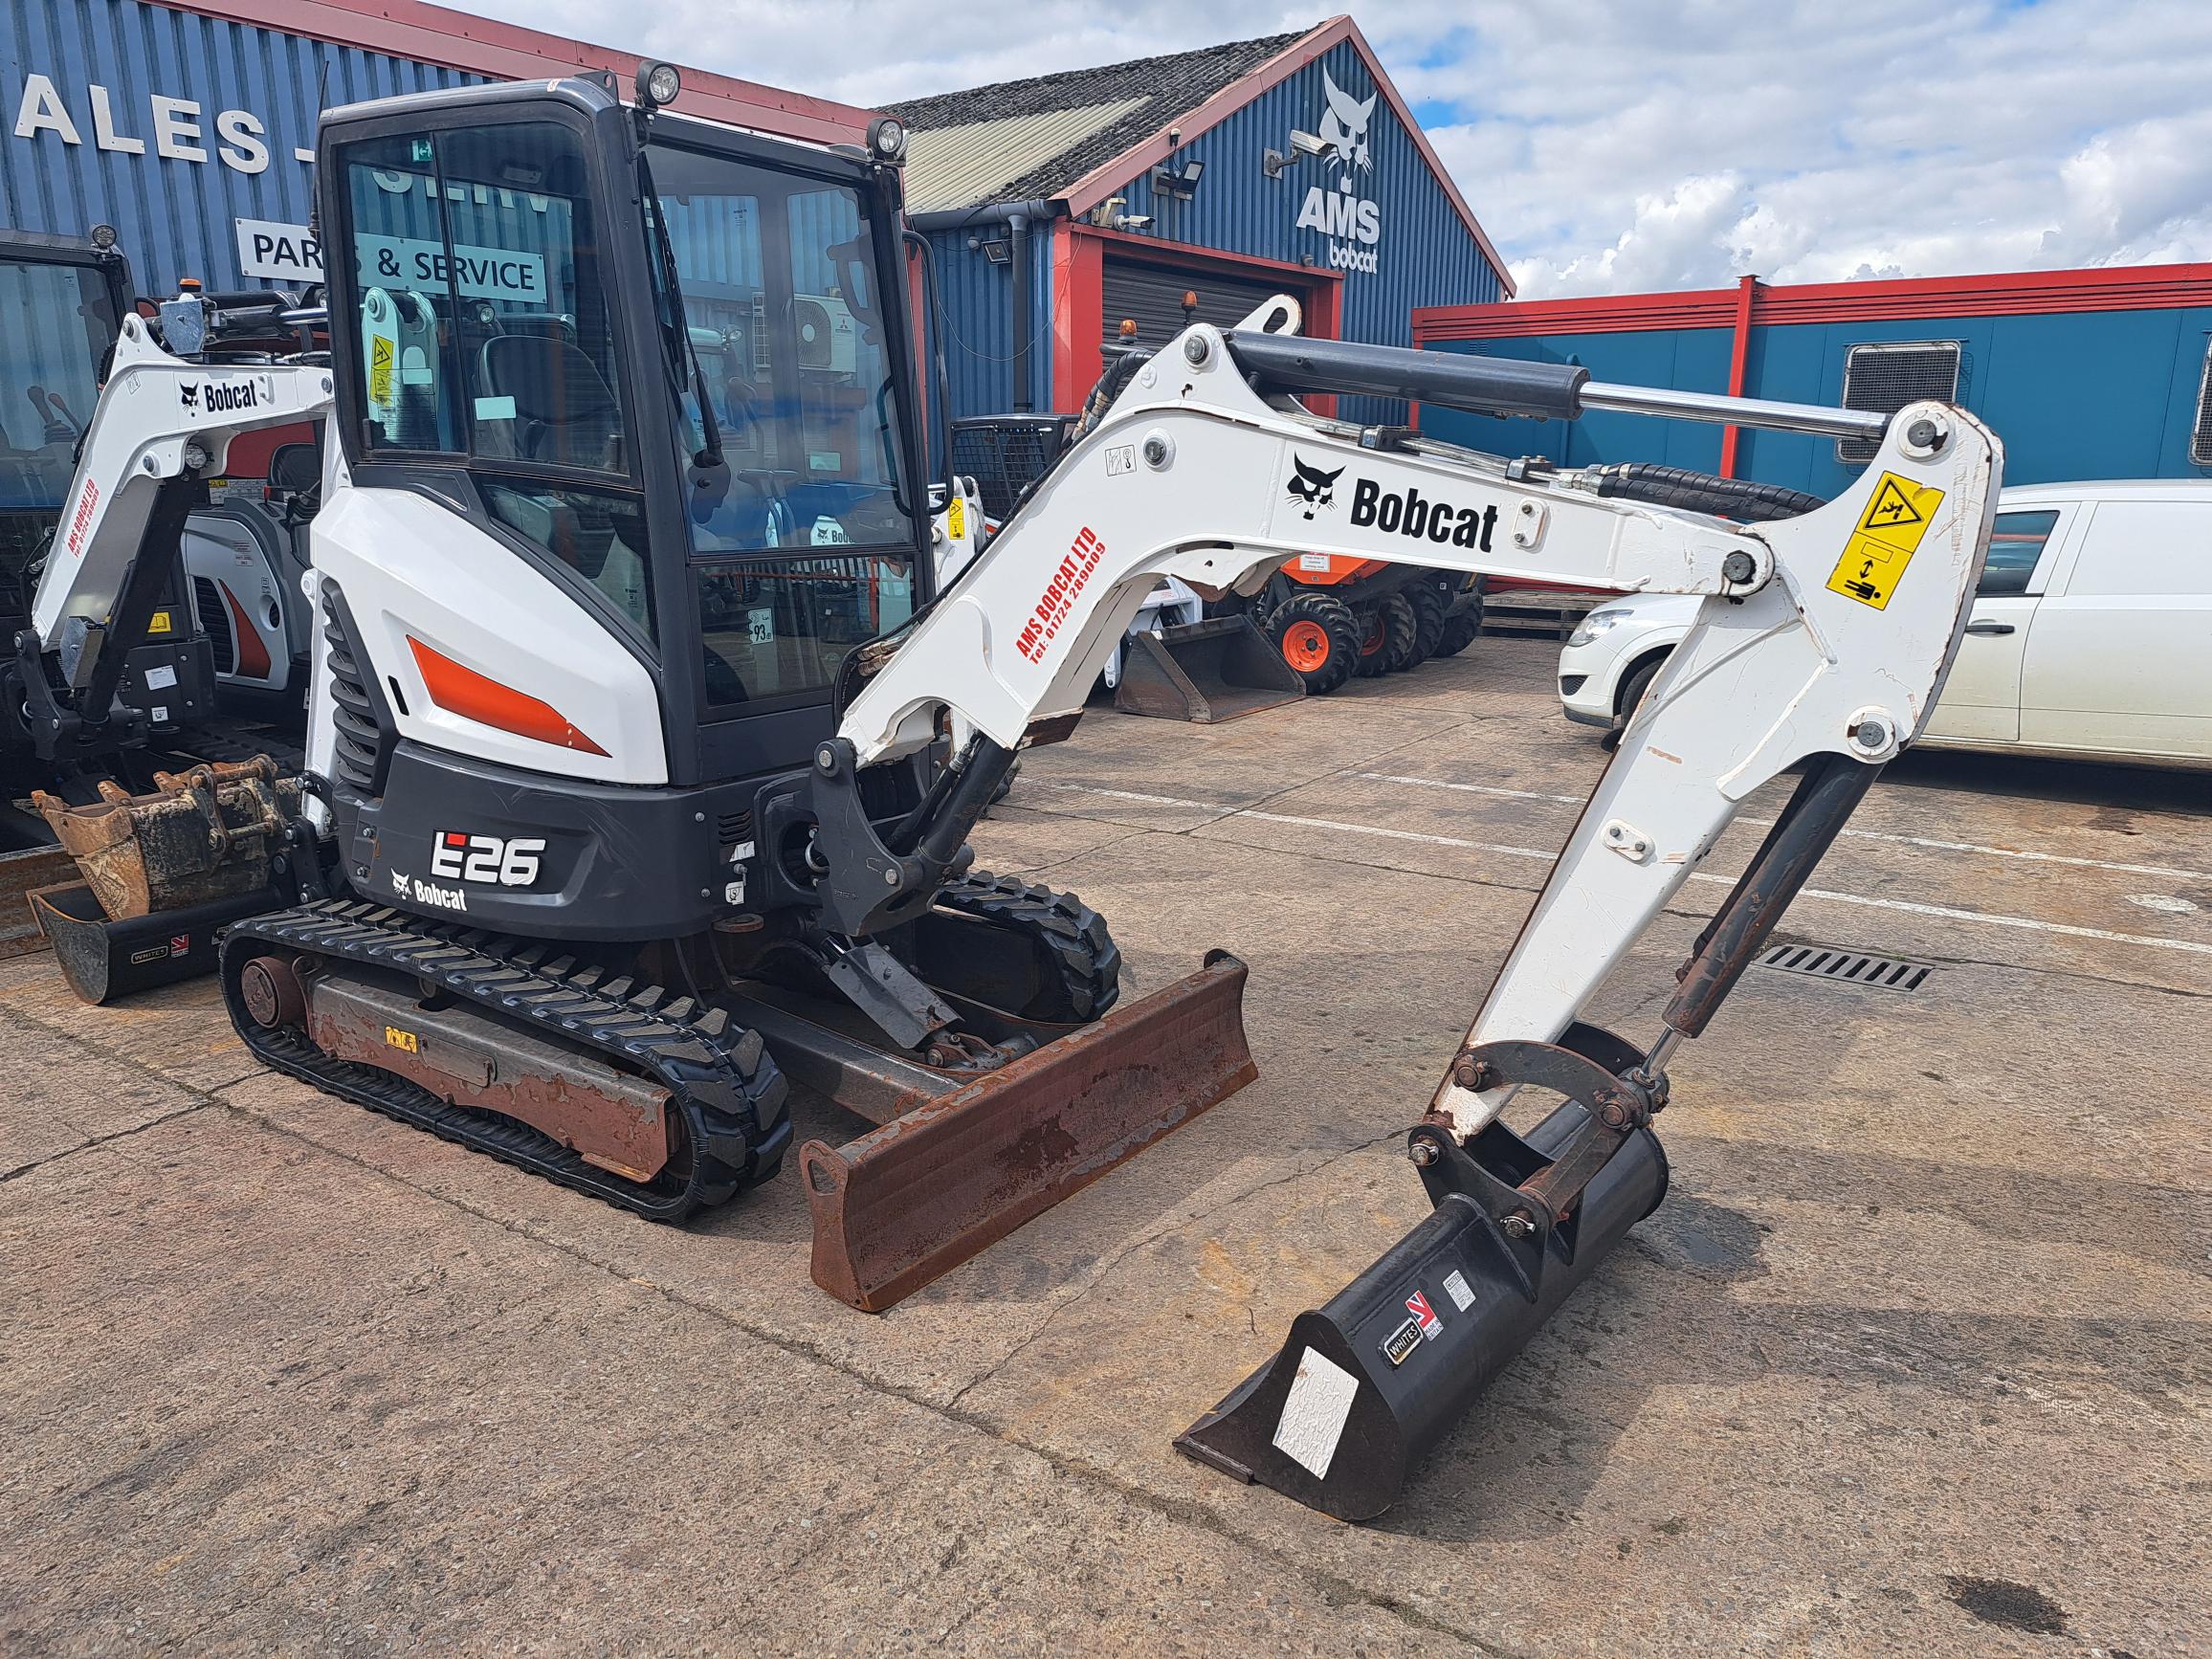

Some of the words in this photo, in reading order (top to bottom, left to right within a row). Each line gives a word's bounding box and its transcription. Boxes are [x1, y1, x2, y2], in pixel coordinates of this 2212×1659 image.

[13, 74, 269, 174] ALES
[1295, 186, 1380, 245] AMS
[378, 248, 401, 277] &
[414, 252, 535, 290] SERVICE
[1329, 237, 1378, 275] bobcat
[204, 379, 257, 412] Bobcat
[1350, 477, 1498, 553] Bobcat
[67, 529, 78, 553] AMS
[1016, 617, 1044, 658] AMS
[1035, 554, 1079, 623] BOBCAT
[1071, 525, 1097, 562] LTD
[1029, 640, 1050, 665] Tel:
[1045, 598, 1073, 640] 01724
[1069, 542, 1106, 600] 289009
[754, 624, 765, 641] 93
[431, 831, 546, 887] E26
[413, 879, 468, 912] Bobcat
[1388, 1325, 1418, 1357] WHITES
